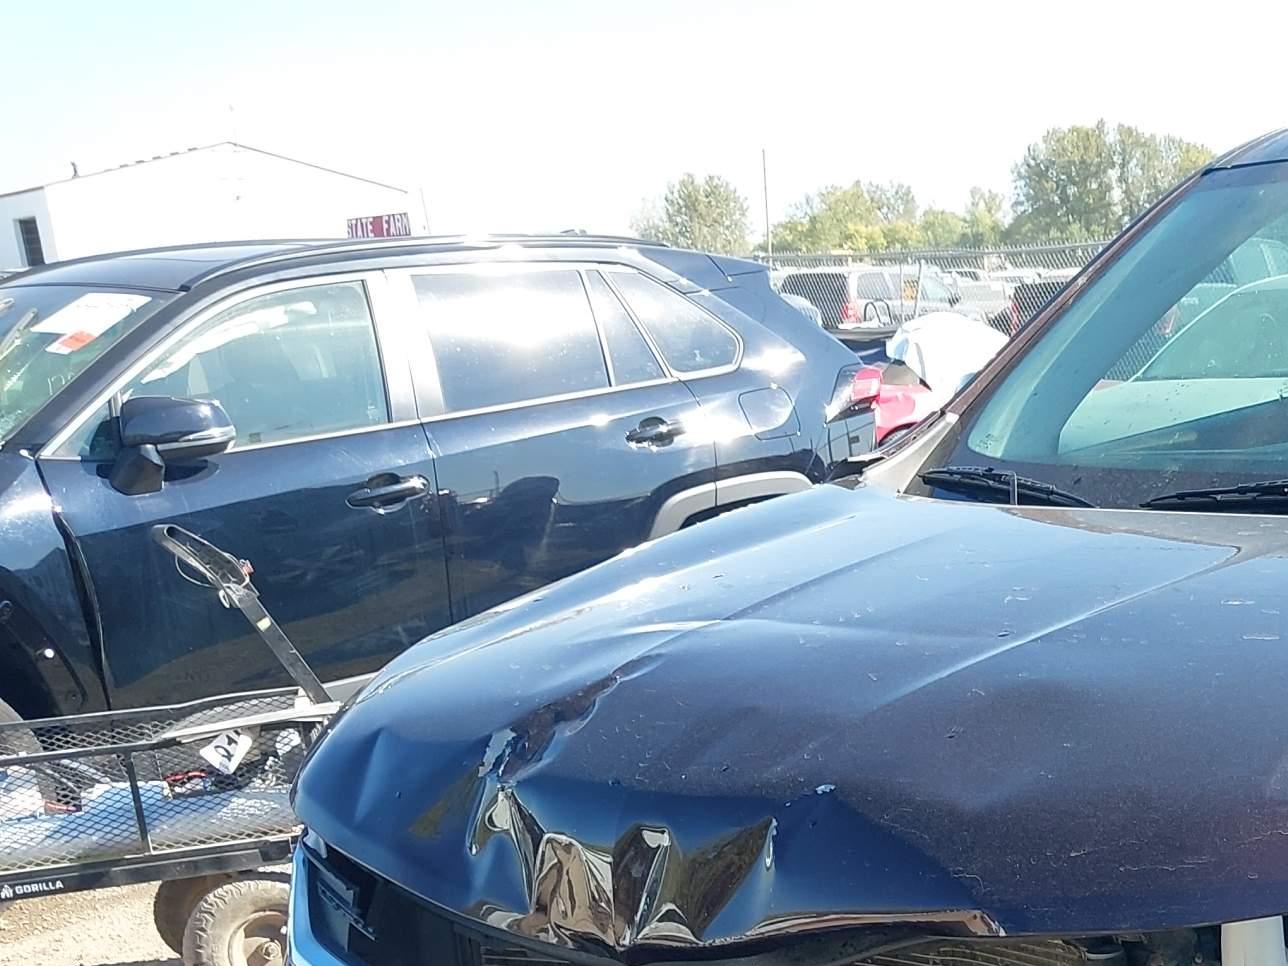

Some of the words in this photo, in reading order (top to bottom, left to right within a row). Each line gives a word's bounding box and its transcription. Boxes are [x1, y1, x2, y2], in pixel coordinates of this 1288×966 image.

[346, 217, 375, 239] STATE
[382, 212, 412, 237] FARM
[14, 879, 65, 895] GORILLA
